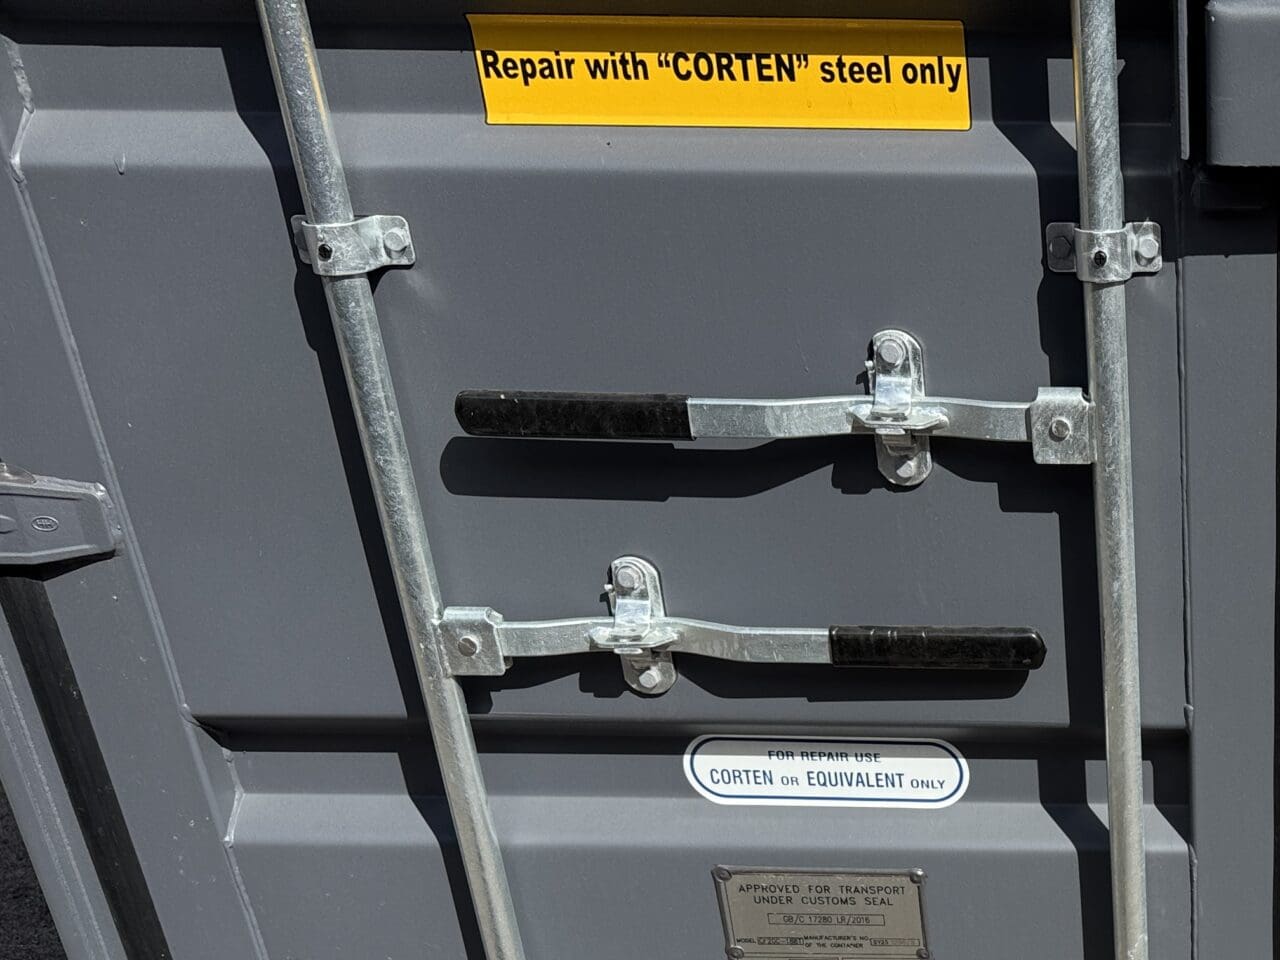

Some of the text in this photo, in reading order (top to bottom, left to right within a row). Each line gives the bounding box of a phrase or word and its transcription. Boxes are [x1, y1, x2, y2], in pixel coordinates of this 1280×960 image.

[482, 50, 575, 86] Repair
[585, 51, 649, 81] with
[820, 56, 891, 84] steel
[902, 57, 962, 92] only
[767, 749, 881, 763] FOR REPAIR USE
[710, 768, 946, 790] CORTEN OR EQUIVALENT ONLY
[738, 884, 906, 895] APPROVED FOR TRANSPORT
[754, 895, 894, 906] UNDER CUSTOMS SEAL
